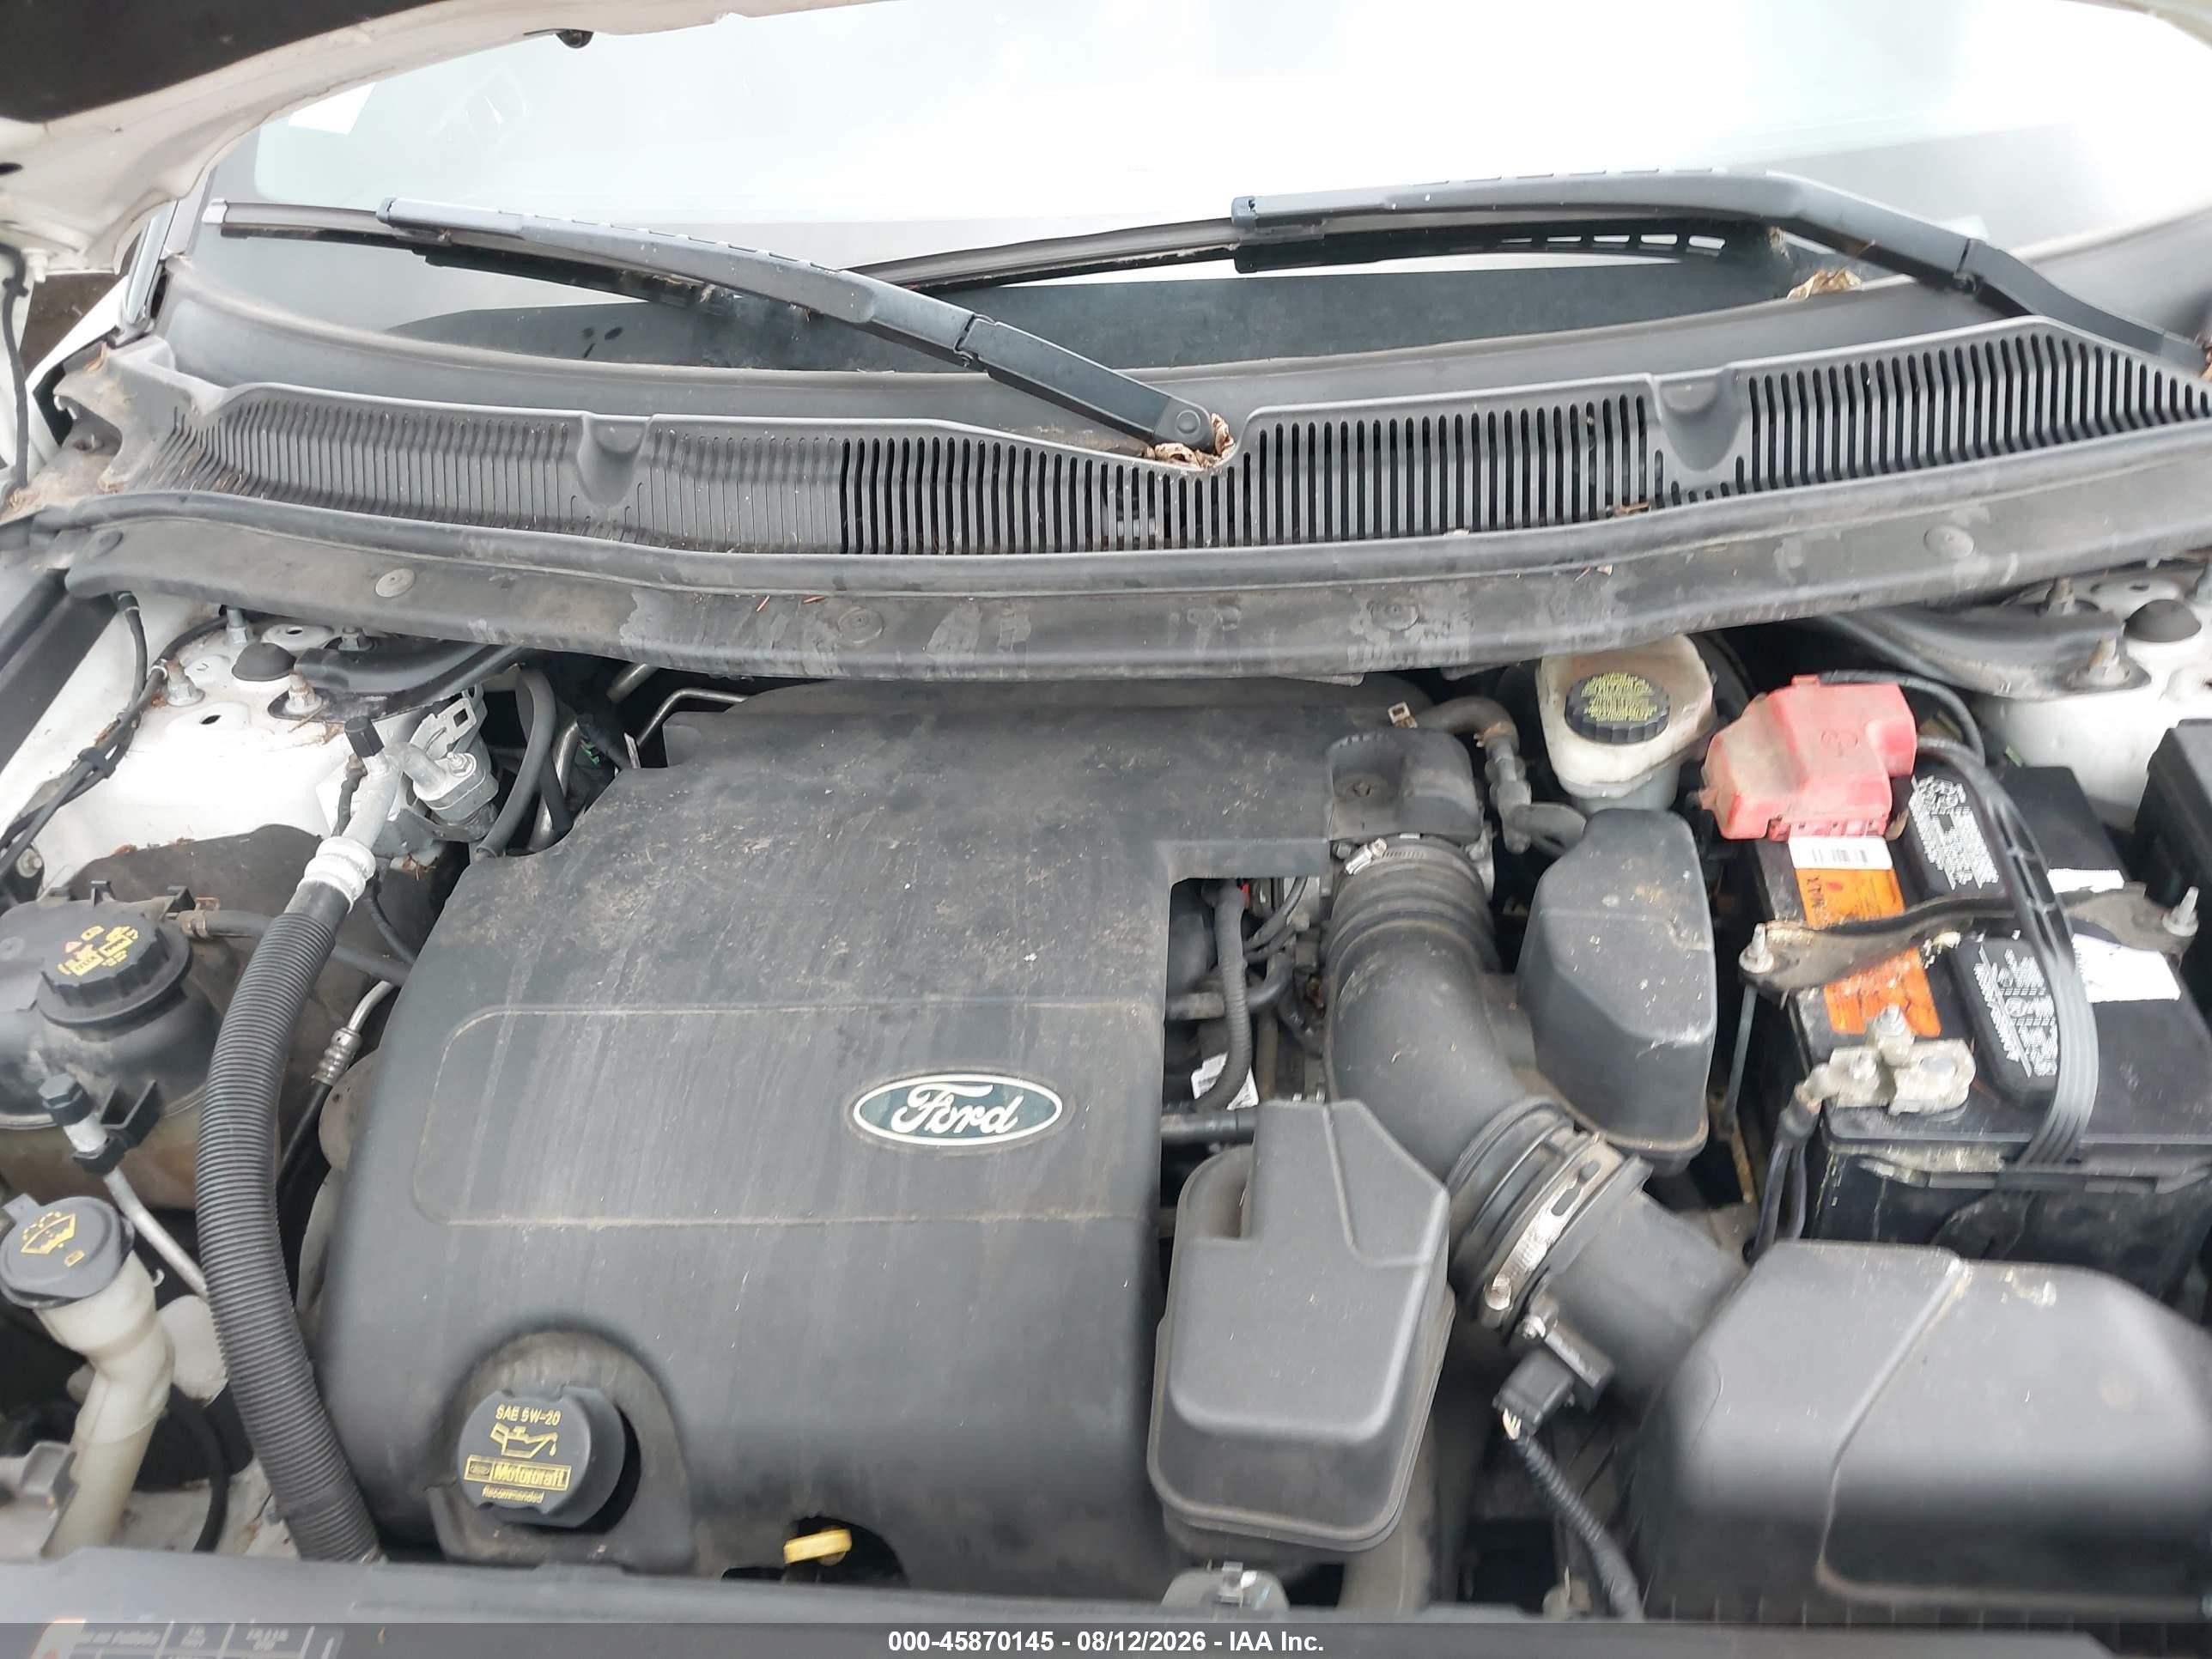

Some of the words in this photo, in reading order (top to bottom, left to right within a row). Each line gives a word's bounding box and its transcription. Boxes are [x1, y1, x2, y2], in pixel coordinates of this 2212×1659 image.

[891, 1083, 1024, 1133] Ford
[495, 1404, 520, 1421] SAE
[520, 1407, 562, 1426] 5W-20
[493, 1462, 566, 1487] Motorcraft
[482, 1485, 545, 1504] Recommended
